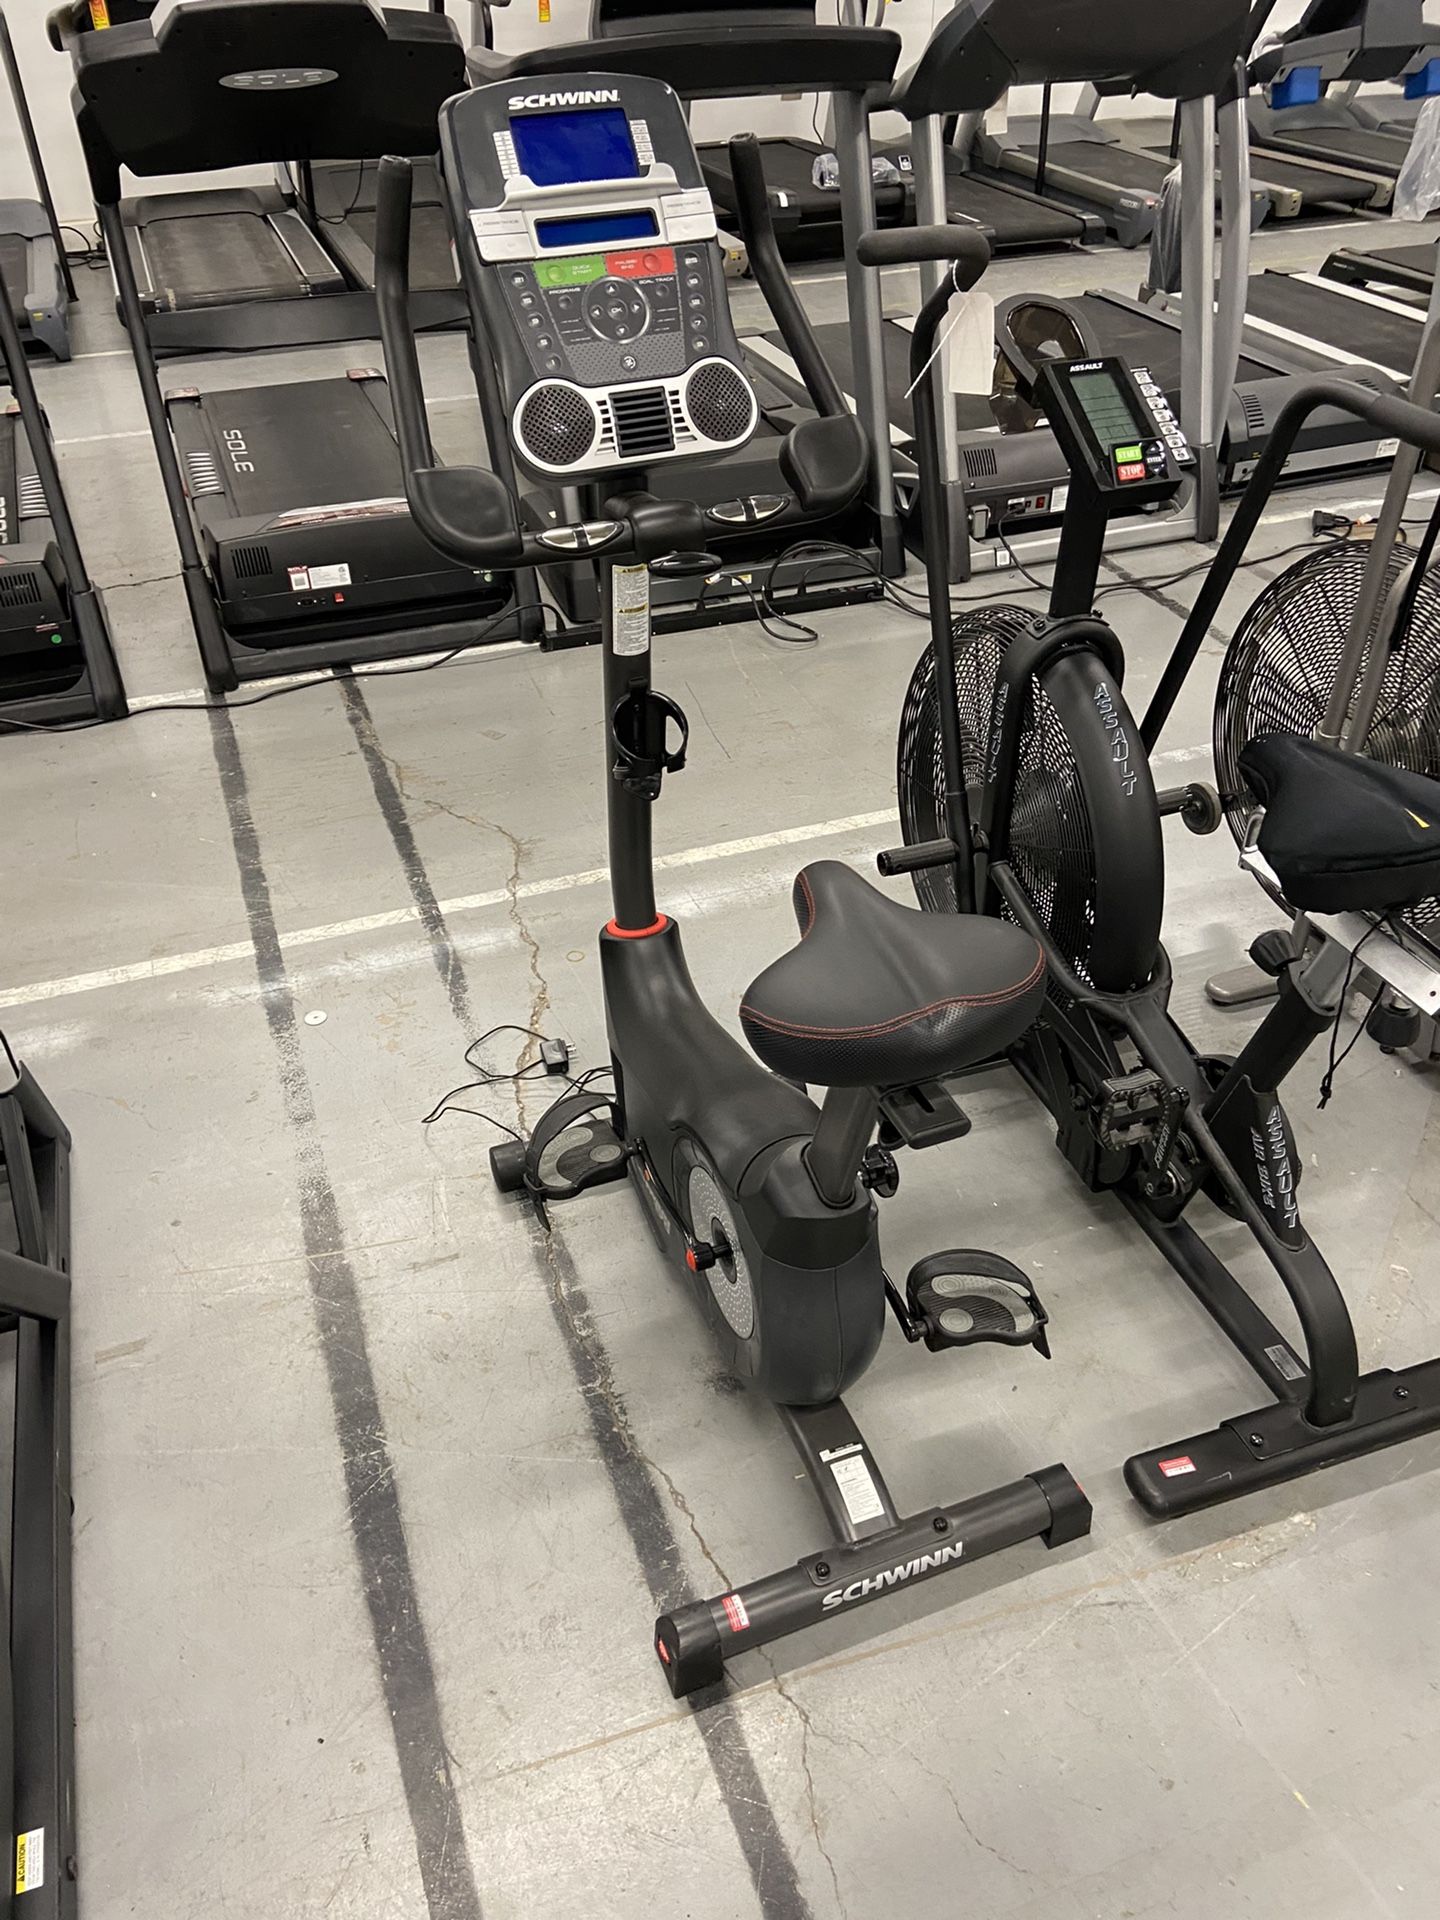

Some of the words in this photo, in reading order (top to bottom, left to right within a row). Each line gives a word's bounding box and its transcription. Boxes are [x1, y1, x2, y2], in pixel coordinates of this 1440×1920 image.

[508, 89, 619, 110] SCHWINN
[549, 287, 581, 295] PROGRAMS
[1069, 362, 1104, 373] ASSAULT
[223, 429, 255, 472] SOLE
[1119, 450, 1141, 459] START
[1120, 465, 1142, 477] STOP
[1093, 682, 1138, 796] ASSAULT
[1266, 1104, 1298, 1229] ASSAULT
[822, 1541, 964, 1611] SCHWINN
[18, 1843, 26, 1875] CAUTION
